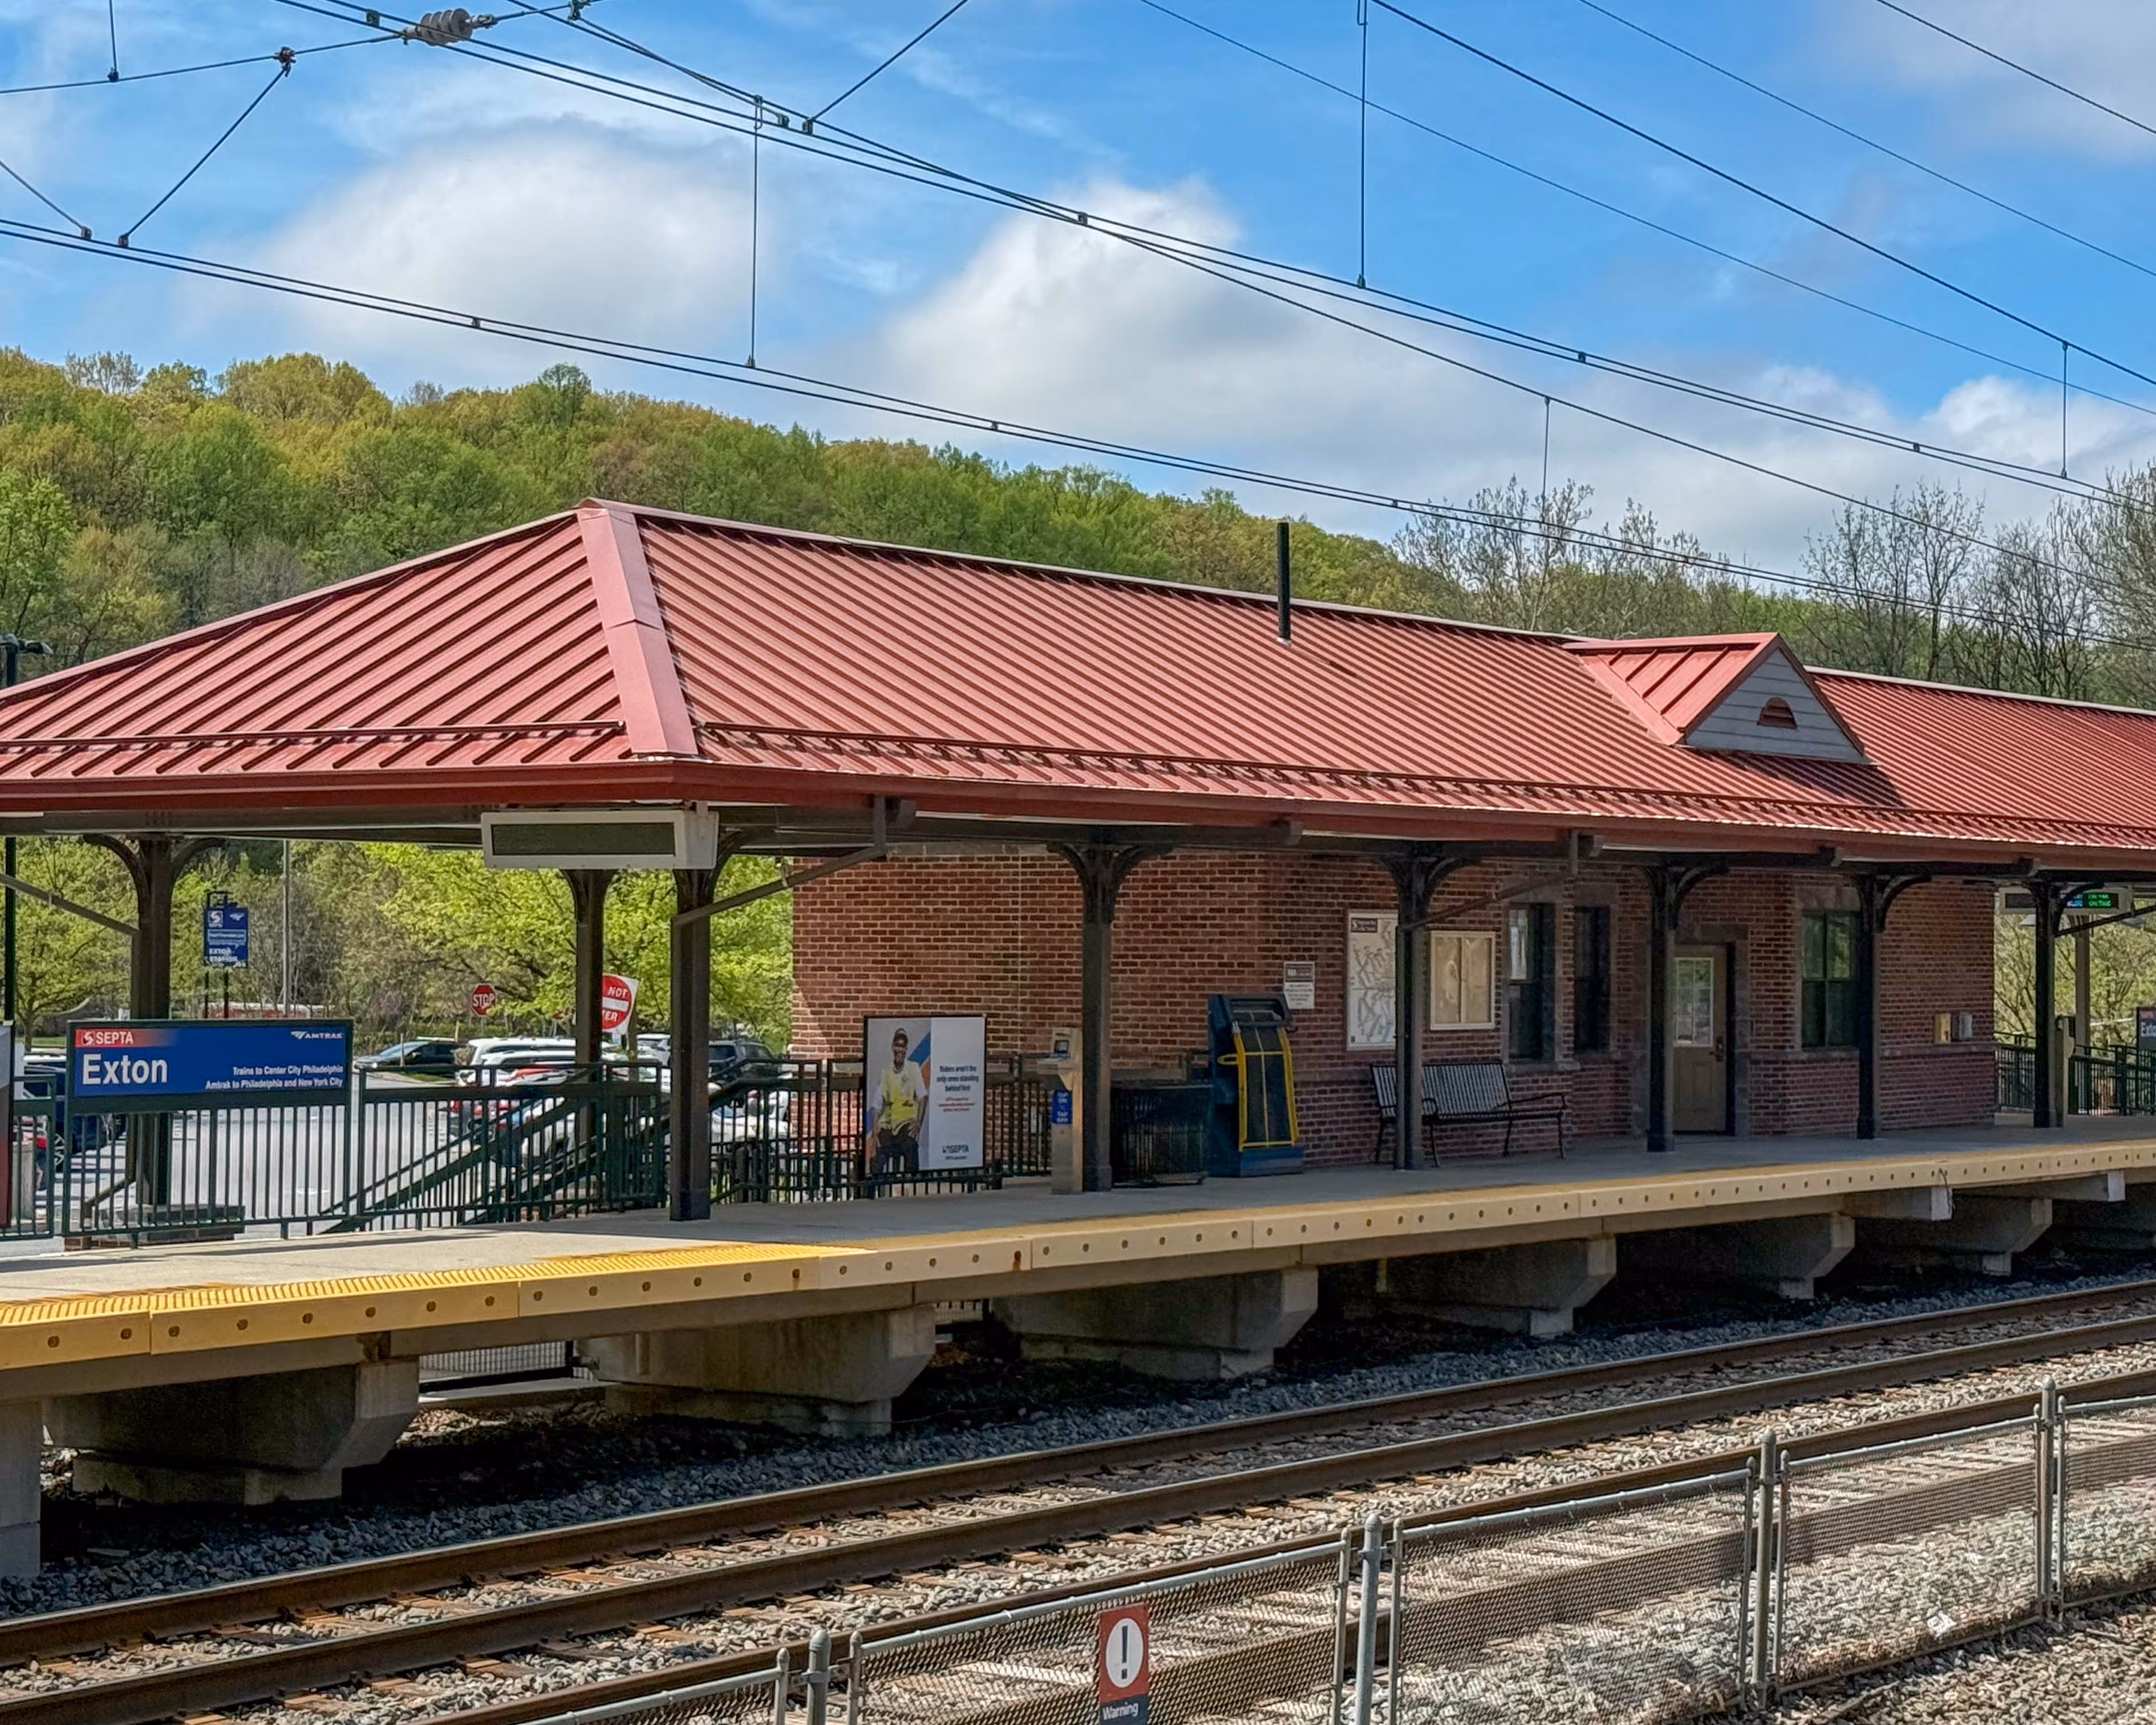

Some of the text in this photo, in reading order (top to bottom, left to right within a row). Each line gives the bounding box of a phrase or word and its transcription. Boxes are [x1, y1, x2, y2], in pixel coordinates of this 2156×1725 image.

[607, 986, 629, 999] NOT
[473, 993, 495, 1007] STOP
[95, 1031, 133, 1045] SEPTA
[83, 1053, 168, 1085] Exton
[233, 1064, 343, 1076] Trains to Center City Philadelphia
[205, 1077, 343, 1090] Amtrak to Philadelphia and New York City
[1103, 1701, 1139, 1720] Warning
